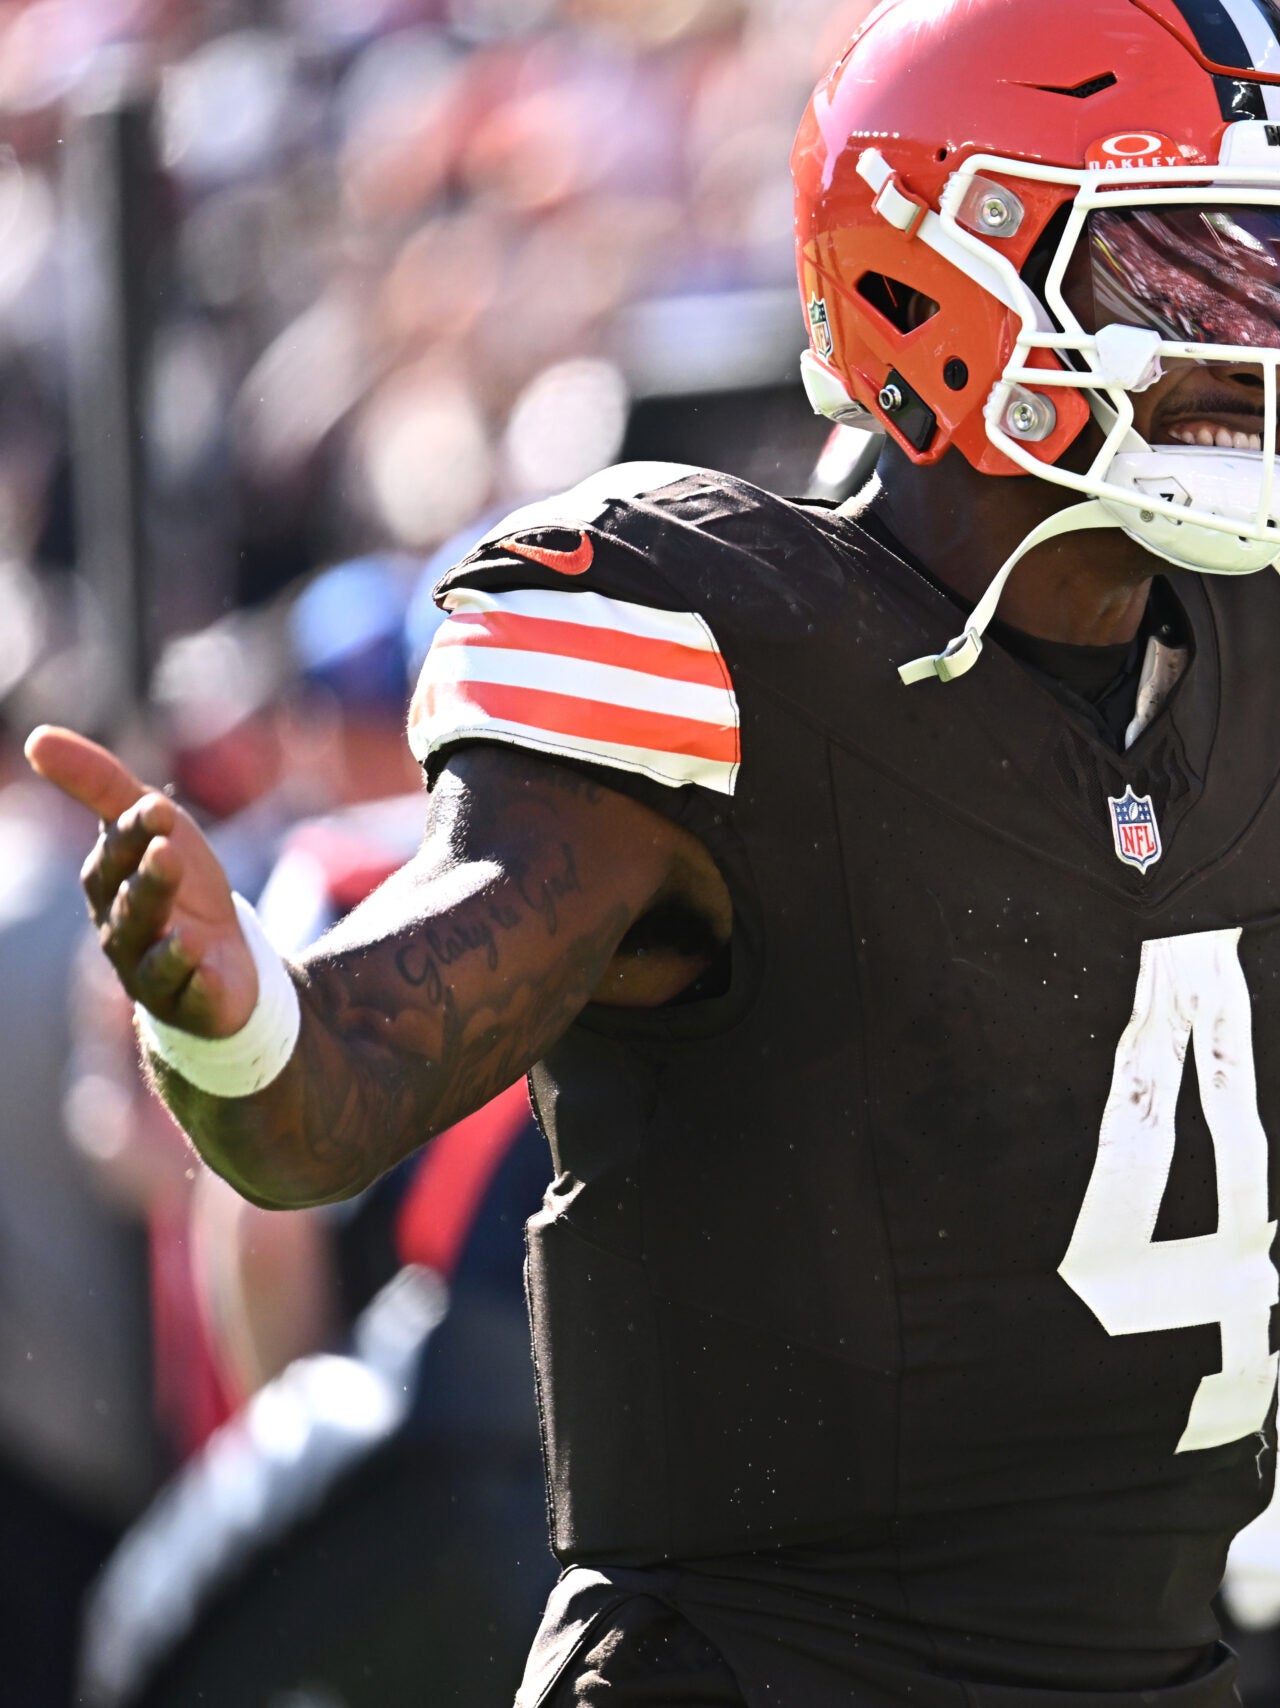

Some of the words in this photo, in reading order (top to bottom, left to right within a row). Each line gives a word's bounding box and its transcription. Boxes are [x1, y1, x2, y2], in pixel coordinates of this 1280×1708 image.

[1088, 156, 1176, 170] OAKLEY
[1121, 825, 1155, 857] NFL
[1057, 927, 1279, 1453] 4
